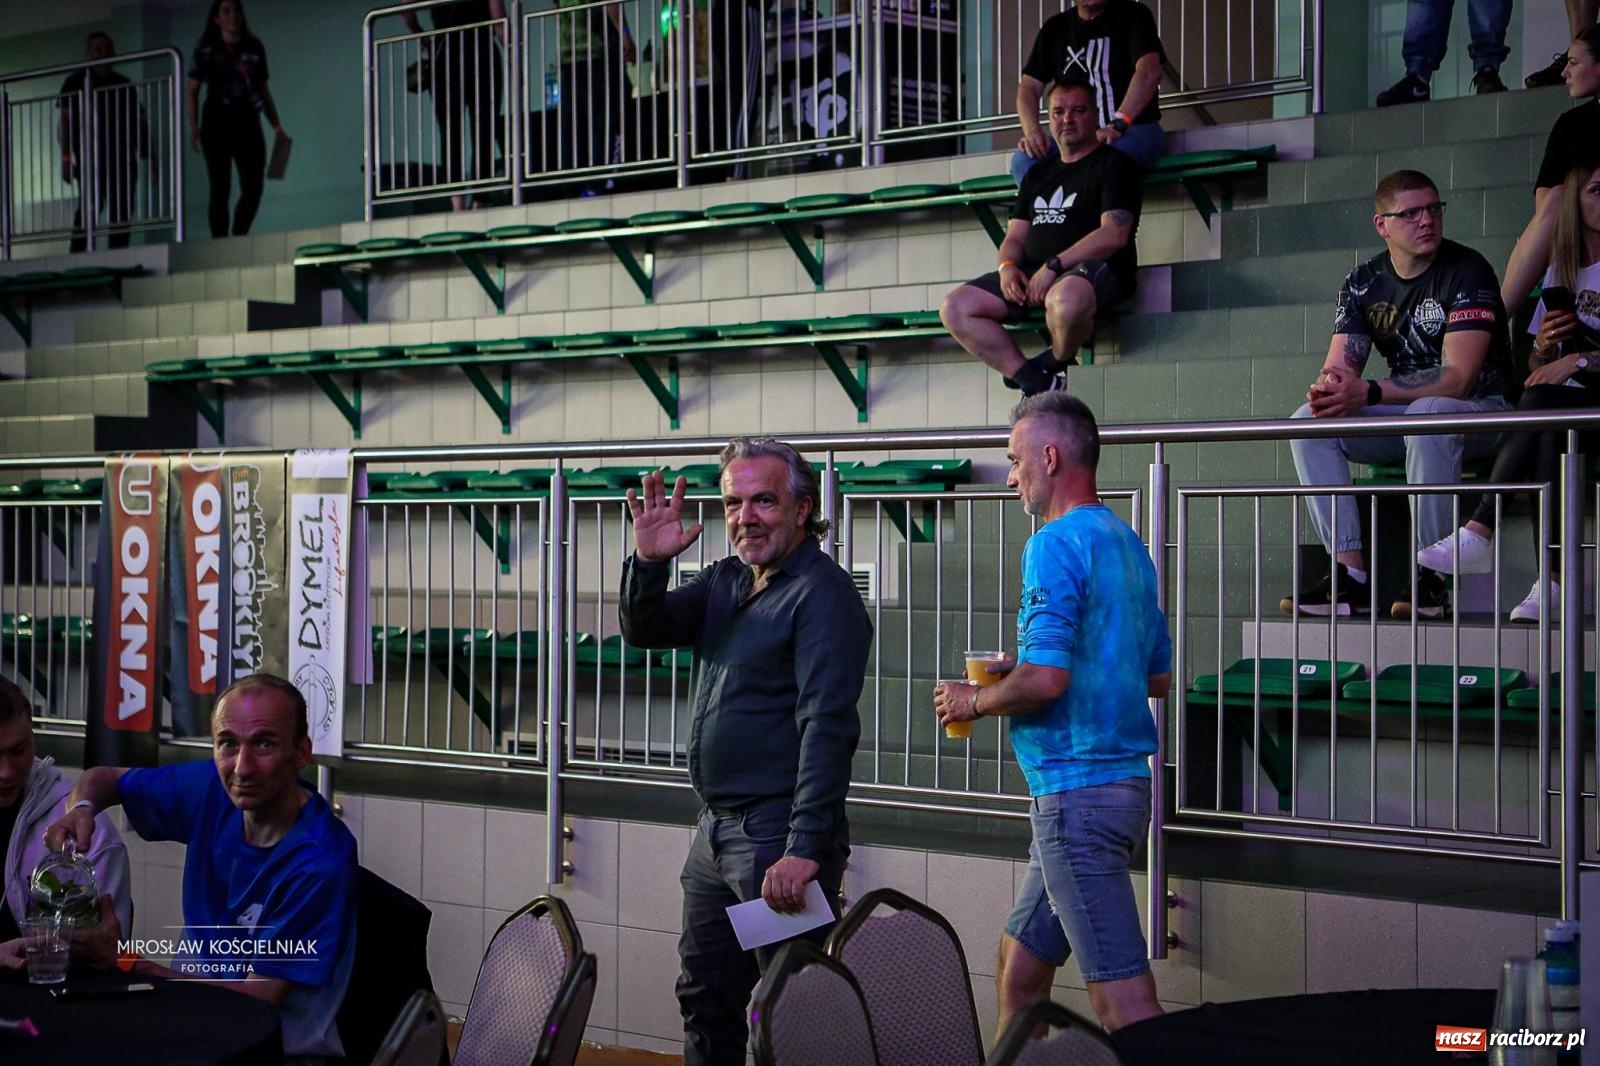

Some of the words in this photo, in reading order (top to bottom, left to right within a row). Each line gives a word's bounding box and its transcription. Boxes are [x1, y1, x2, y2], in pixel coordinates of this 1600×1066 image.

[118, 525, 150, 721] OKNA
[192, 482, 221, 684] OKNA
[298, 496, 324, 649] DYMEL
